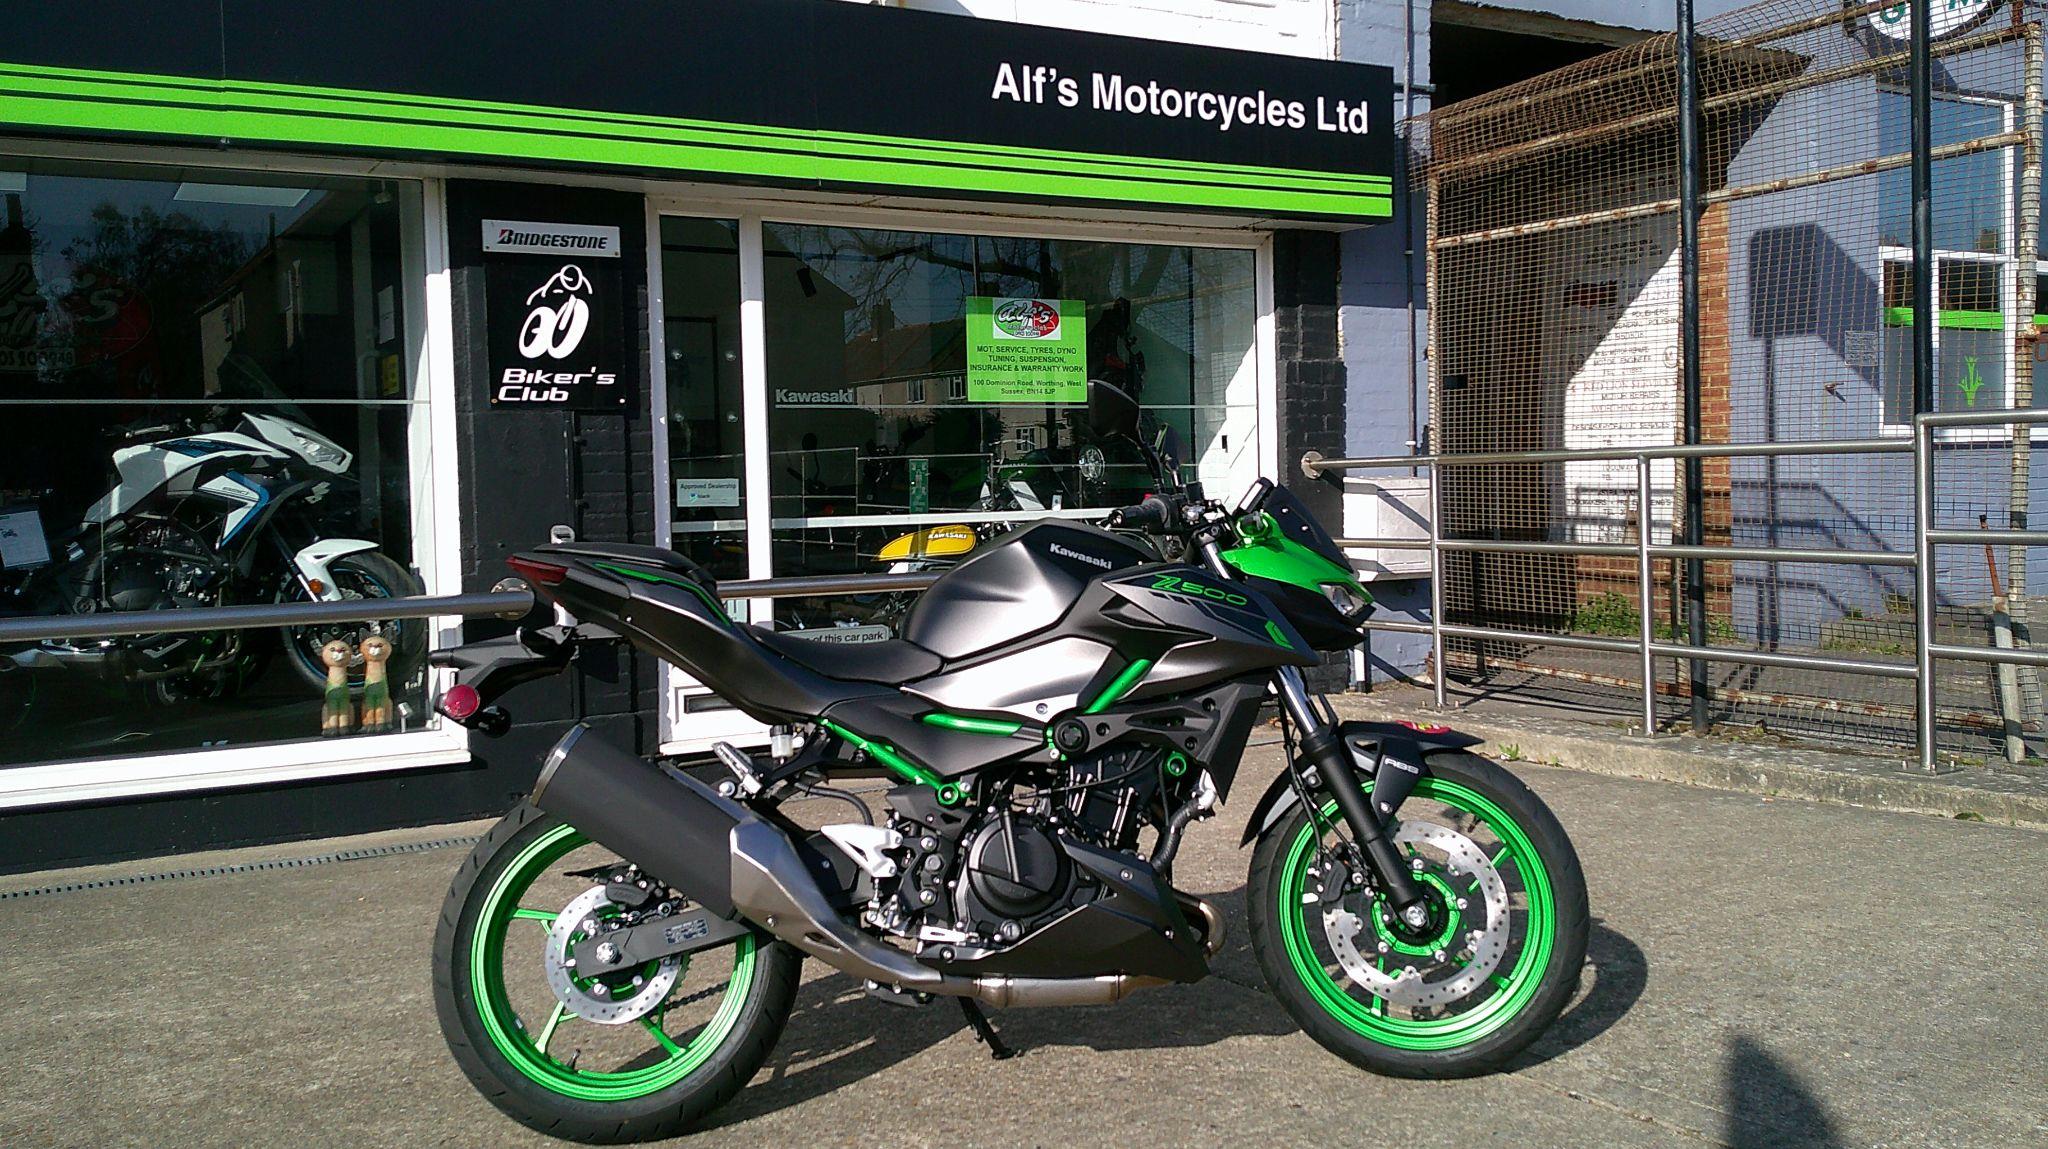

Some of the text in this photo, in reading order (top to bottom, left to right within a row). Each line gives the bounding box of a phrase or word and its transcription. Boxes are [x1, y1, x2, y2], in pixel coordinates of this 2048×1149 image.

[992, 62, 1369, 134] Alf's Motorcycles Ltd
[497, 229, 608, 249] BRIDGESTONE
[996, 346, 1029, 354] SERVICE,
[1057, 347, 1077, 355] DYNO
[988, 355, 1067, 363] TUNING, SUSPENSION,
[502, 366, 616, 385] Biker's
[970, 364, 1012, 372] INSURANCE
[498, 386, 570, 402] Club
[775, 388, 854, 404] Kawasaki
[680, 482, 736, 490] Approved Dealership
[928, 532, 967, 540] KAWASAKI
[1050, 543, 1112, 570] Kawasaki
[1152, 573, 1248, 606] Z500
[824, 632, 842, 642] this
[844, 634, 861, 642] car
[862, 631, 883, 643] park
[1384, 757, 1420, 775] ABS
